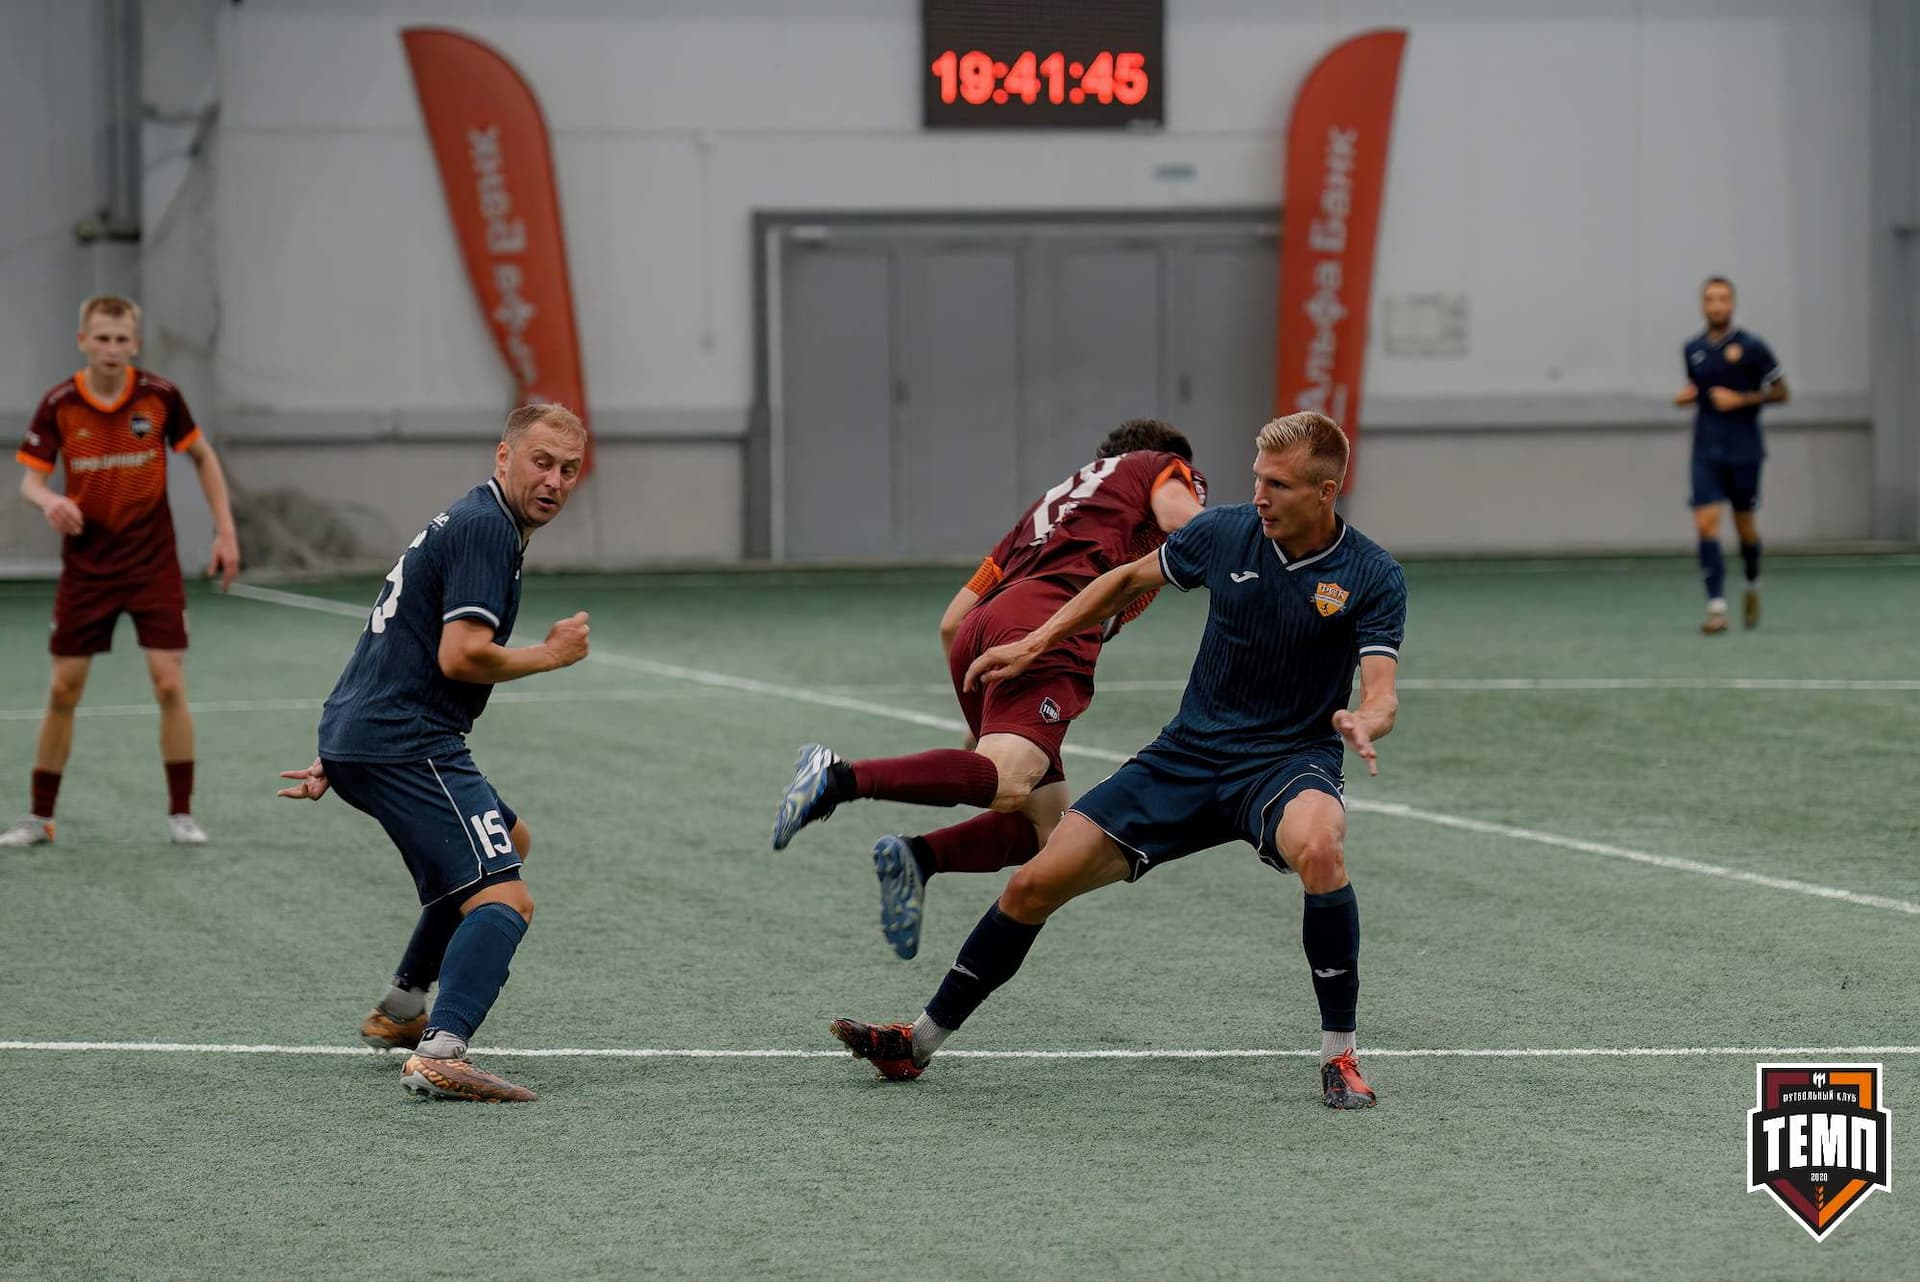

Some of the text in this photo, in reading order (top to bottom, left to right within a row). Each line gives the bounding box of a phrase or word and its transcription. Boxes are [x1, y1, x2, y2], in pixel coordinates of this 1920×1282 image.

[931, 50, 1149, 105] 19:41:45
[1308, 124, 1358, 252] Банк
[470, 809, 513, 859] 15
